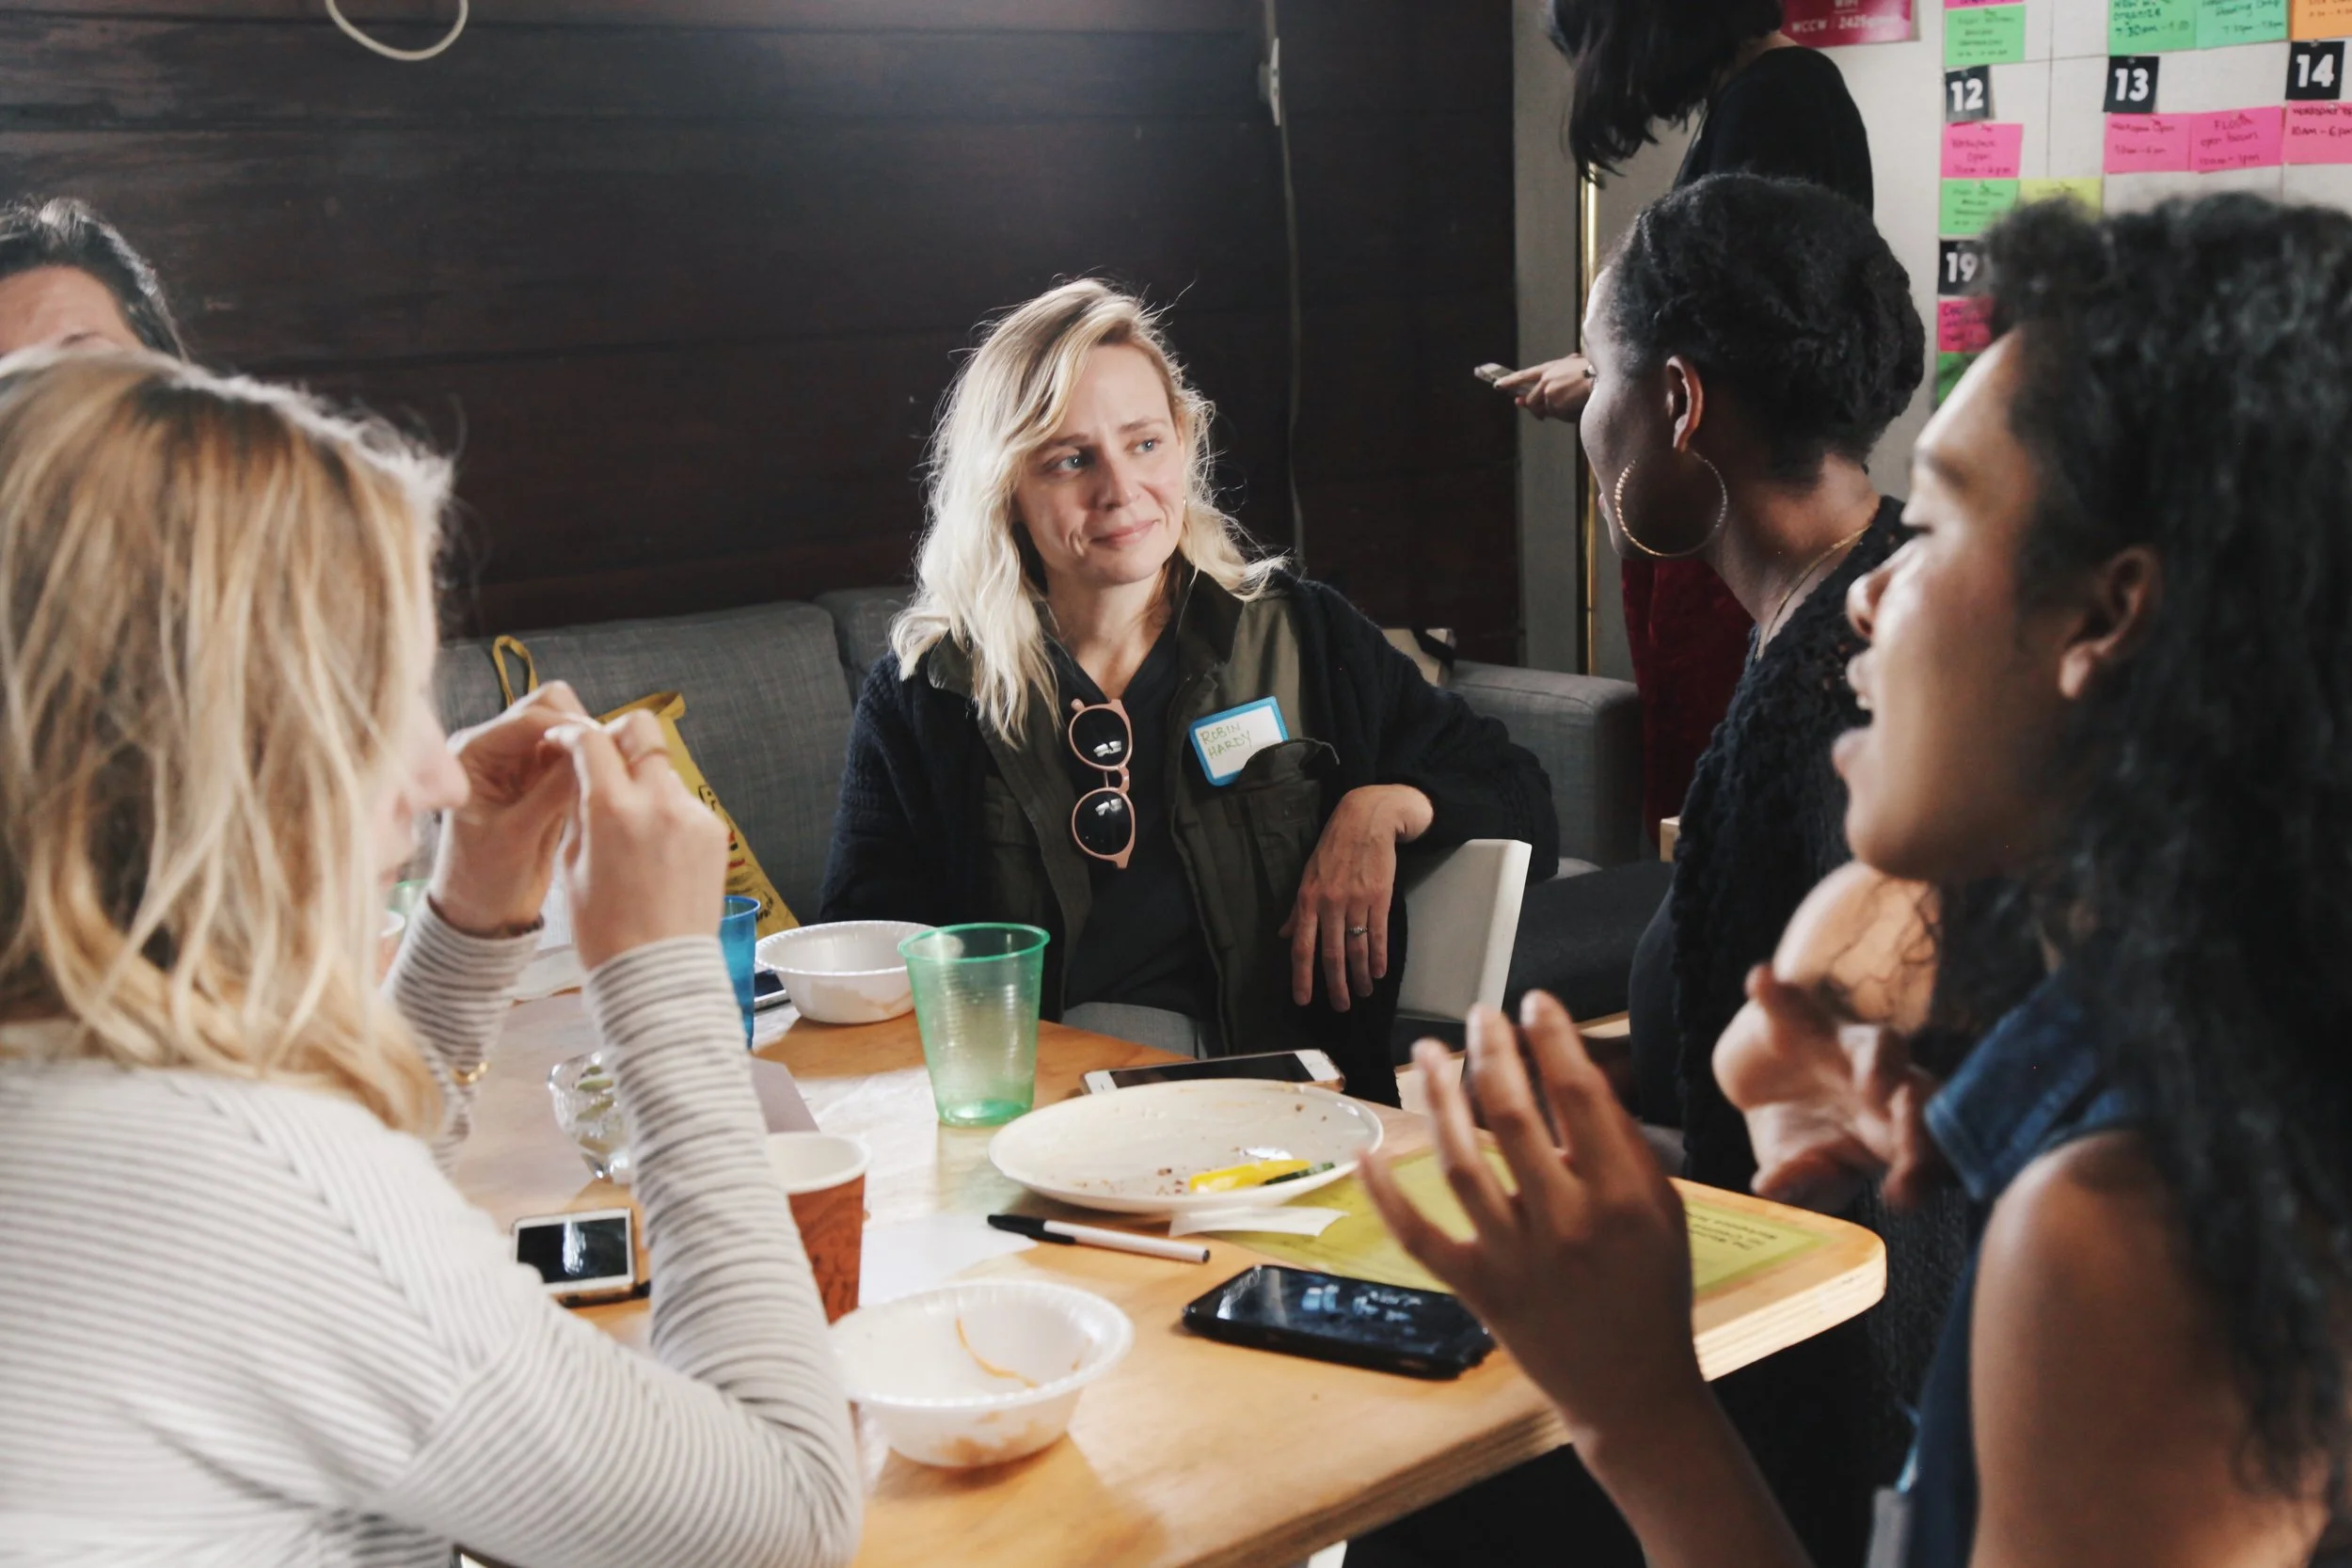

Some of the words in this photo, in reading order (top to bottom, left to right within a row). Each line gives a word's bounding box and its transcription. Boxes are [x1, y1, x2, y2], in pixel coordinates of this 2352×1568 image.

[2115, 68, 2150, 102] 13
[2296, 54, 2334, 87] 14
[1950, 78, 1984, 112] 12
[1947, 252, 1979, 283] 19
[1200, 721, 1241, 745] ROBIN
[1208, 729, 1252, 760] HARDY
